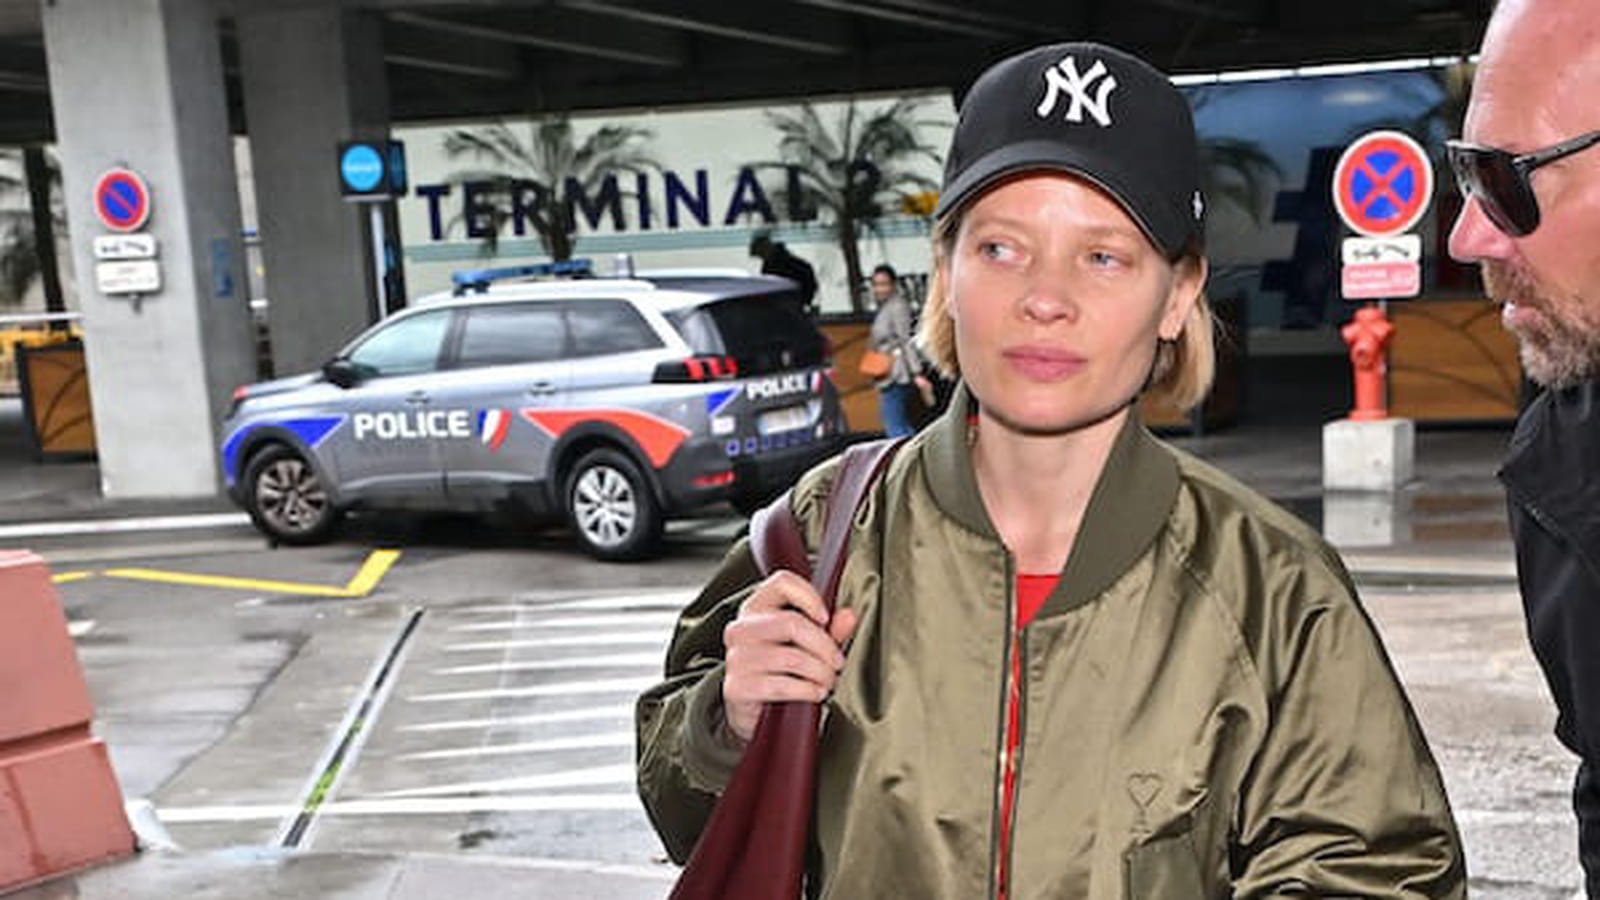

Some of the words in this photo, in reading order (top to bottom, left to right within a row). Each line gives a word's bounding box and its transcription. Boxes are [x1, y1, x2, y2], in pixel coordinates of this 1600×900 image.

[1037, 55, 1117, 126] NY
[416, 165, 819, 241] TERMINAL
[746, 374, 808, 400] POLICE
[353, 409, 471, 440] POLICE
